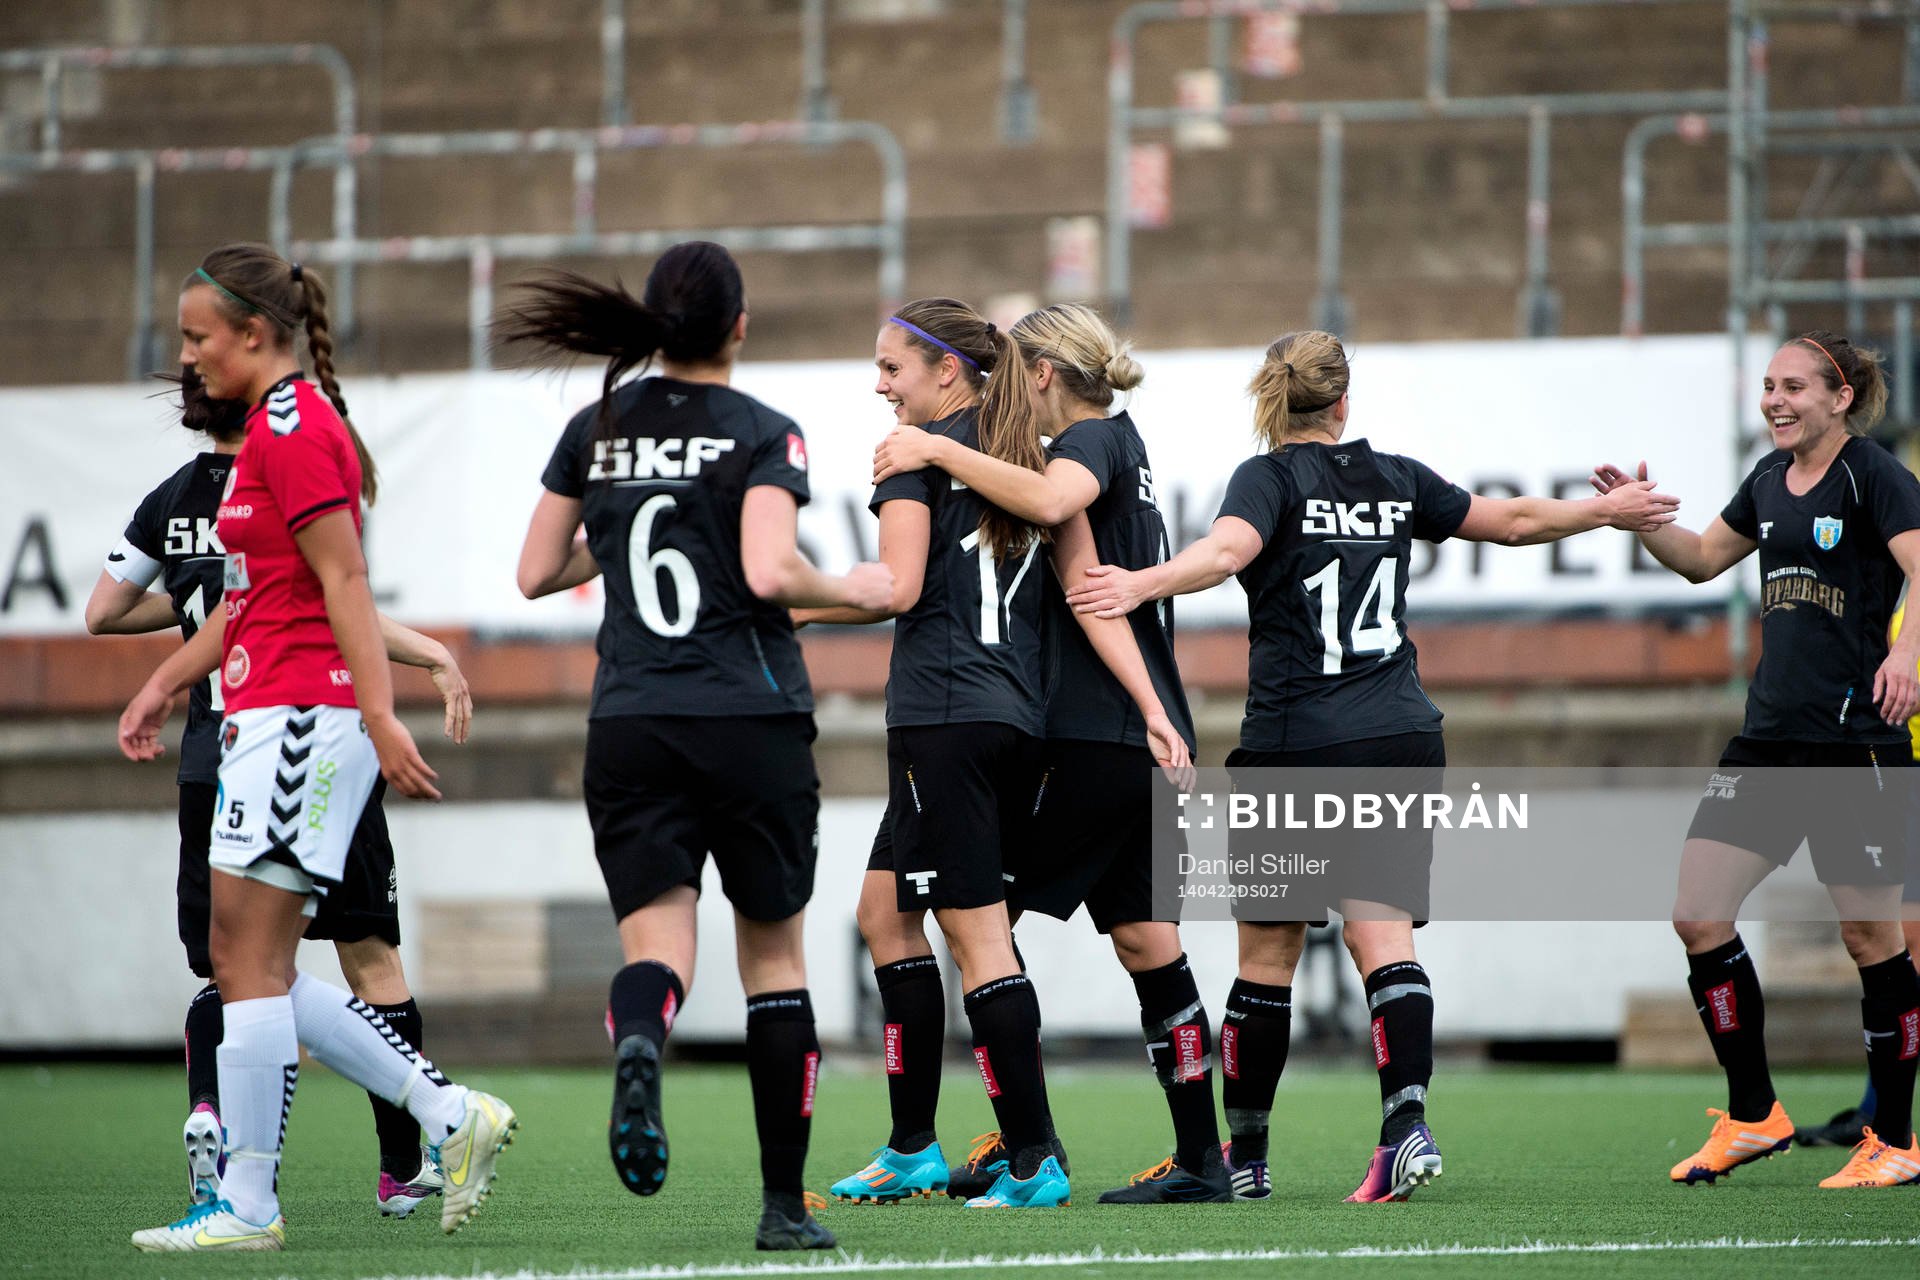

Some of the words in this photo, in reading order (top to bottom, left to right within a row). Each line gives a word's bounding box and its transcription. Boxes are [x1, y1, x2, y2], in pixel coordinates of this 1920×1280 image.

[588, 436, 735, 481] SKF
[164, 517, 228, 556] SK
[1302, 498, 1413, 536] SKF
[629, 494, 701, 638] 6
[1303, 557, 1402, 675] 14
[228, 800, 245, 830] 5
[308, 759, 337, 832] PLUS
[972, 978, 1027, 999] TENSON
[1712, 986, 1735, 1030] Stavdal
[887, 1027, 900, 1072] Stavdal
[1179, 1029, 1201, 1080] Stavdal
[1223, 1029, 1236, 1076] Stavdal
[1372, 1022, 1387, 1065] Stavdal
[974, 1051, 996, 1095] Stavdal
